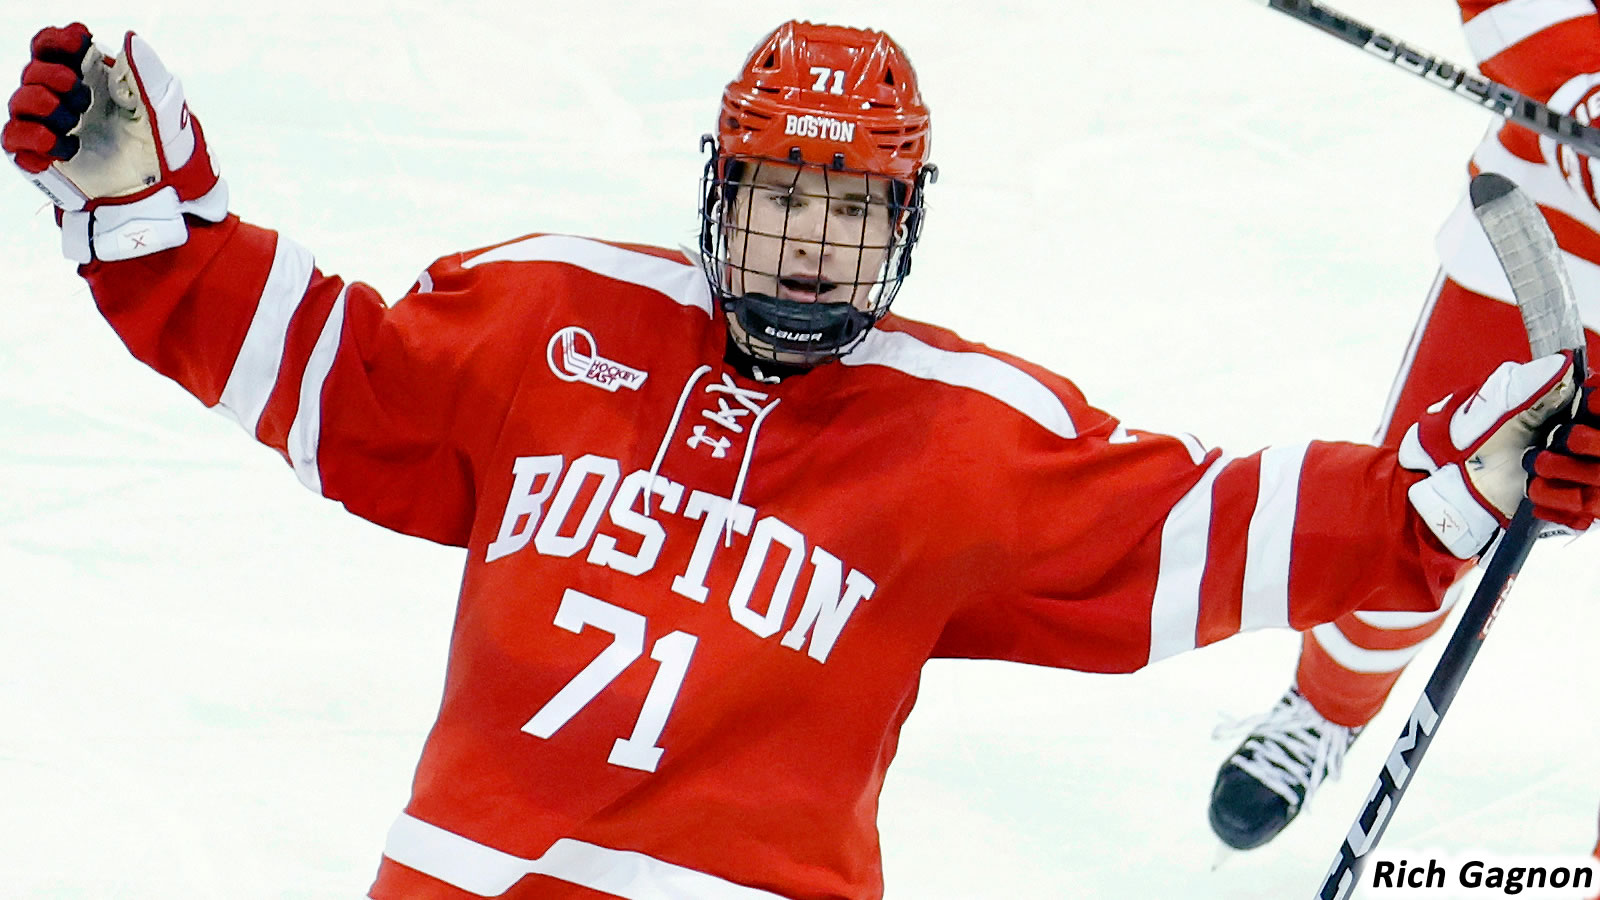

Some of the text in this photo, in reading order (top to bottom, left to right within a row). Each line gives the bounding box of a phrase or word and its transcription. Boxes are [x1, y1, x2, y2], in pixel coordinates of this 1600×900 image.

[809, 66, 847, 96] 71
[784, 114, 856, 143] BOSTON
[764, 325, 823, 343] BAUER
[586, 369, 618, 386] EAST
[590, 360, 640, 383] HOCKEY
[485, 453, 877, 664] BOSTON
[520, 588, 699, 773] 71
